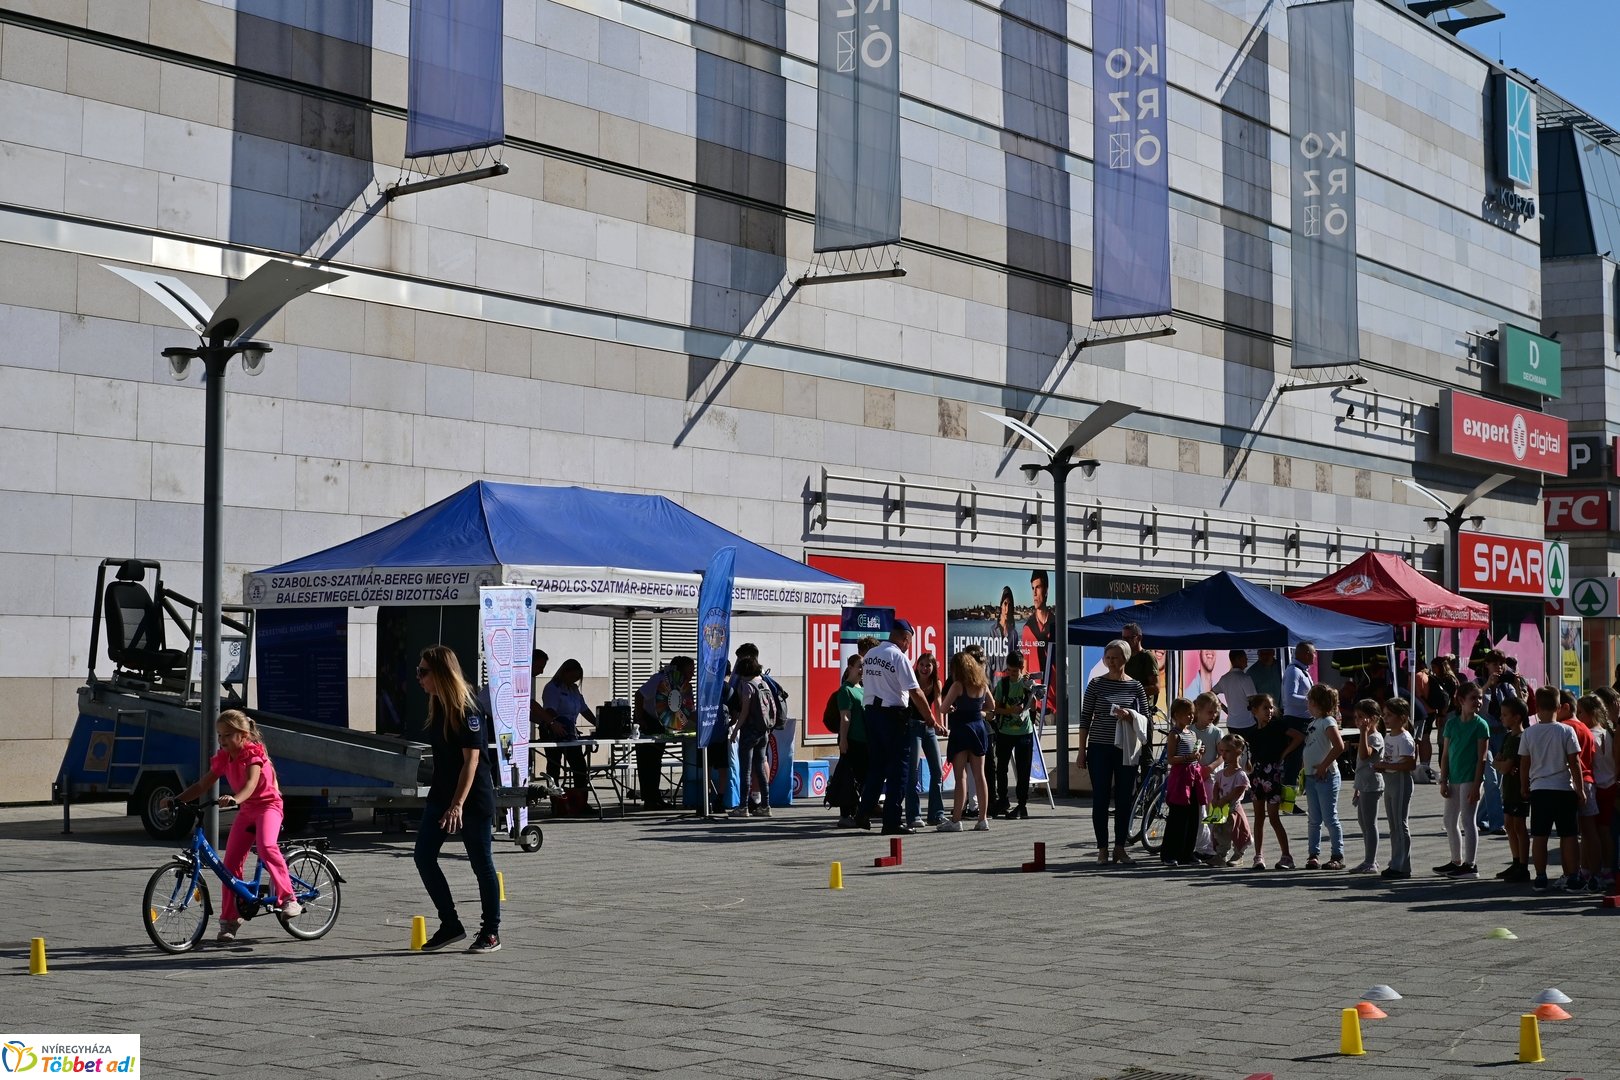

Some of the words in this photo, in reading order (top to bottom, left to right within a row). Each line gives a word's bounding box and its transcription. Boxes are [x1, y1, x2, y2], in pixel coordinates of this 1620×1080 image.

[1529, 340, 1539, 369] D
[1463, 417, 1509, 444] expert
[1530, 429, 1560, 455] digital
[1544, 495, 1600, 526] FC
[1473, 542, 1543, 586] SPAR
[271, 571, 423, 589] SZABOLCS-SZATMÁR-BEREG
[425, 572, 469, 585] MEGYEI
[530, 579, 673, 596] SZABOLCS-SZATMÁR-BEREG
[1109, 581, 1131, 593] VISION
[1132, 583, 1160, 595] EXPRESS
[276, 589, 393, 604] BALESETMEGELŐZÉSI
[395, 588, 459, 602] BIZOTTSÁG
[803, 590, 848, 605] BIZOTTSÁG
[982, 636, 1009, 657] TOOLS
